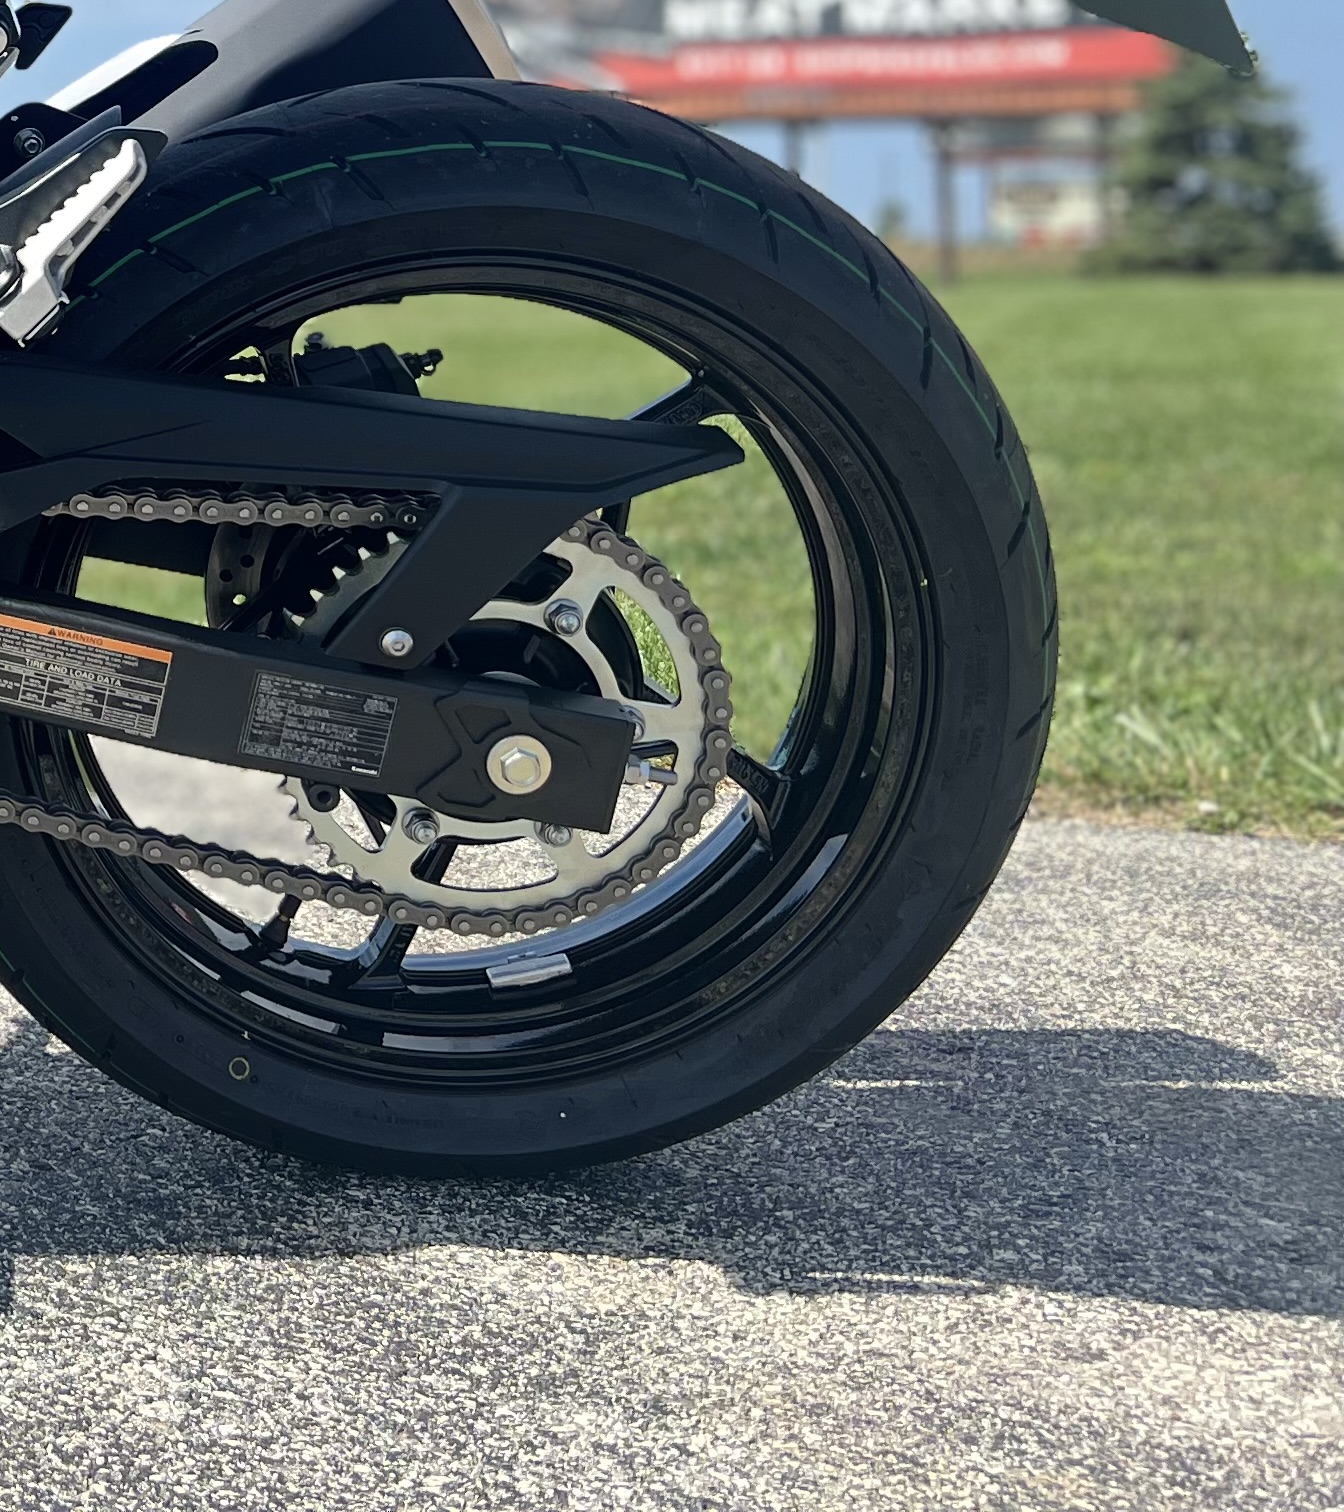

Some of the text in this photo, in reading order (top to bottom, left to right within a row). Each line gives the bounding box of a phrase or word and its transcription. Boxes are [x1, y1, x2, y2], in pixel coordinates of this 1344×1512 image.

[55, 629, 104, 646] WARNING
[25, 657, 122, 687] TIRE AND LOAD DATA
